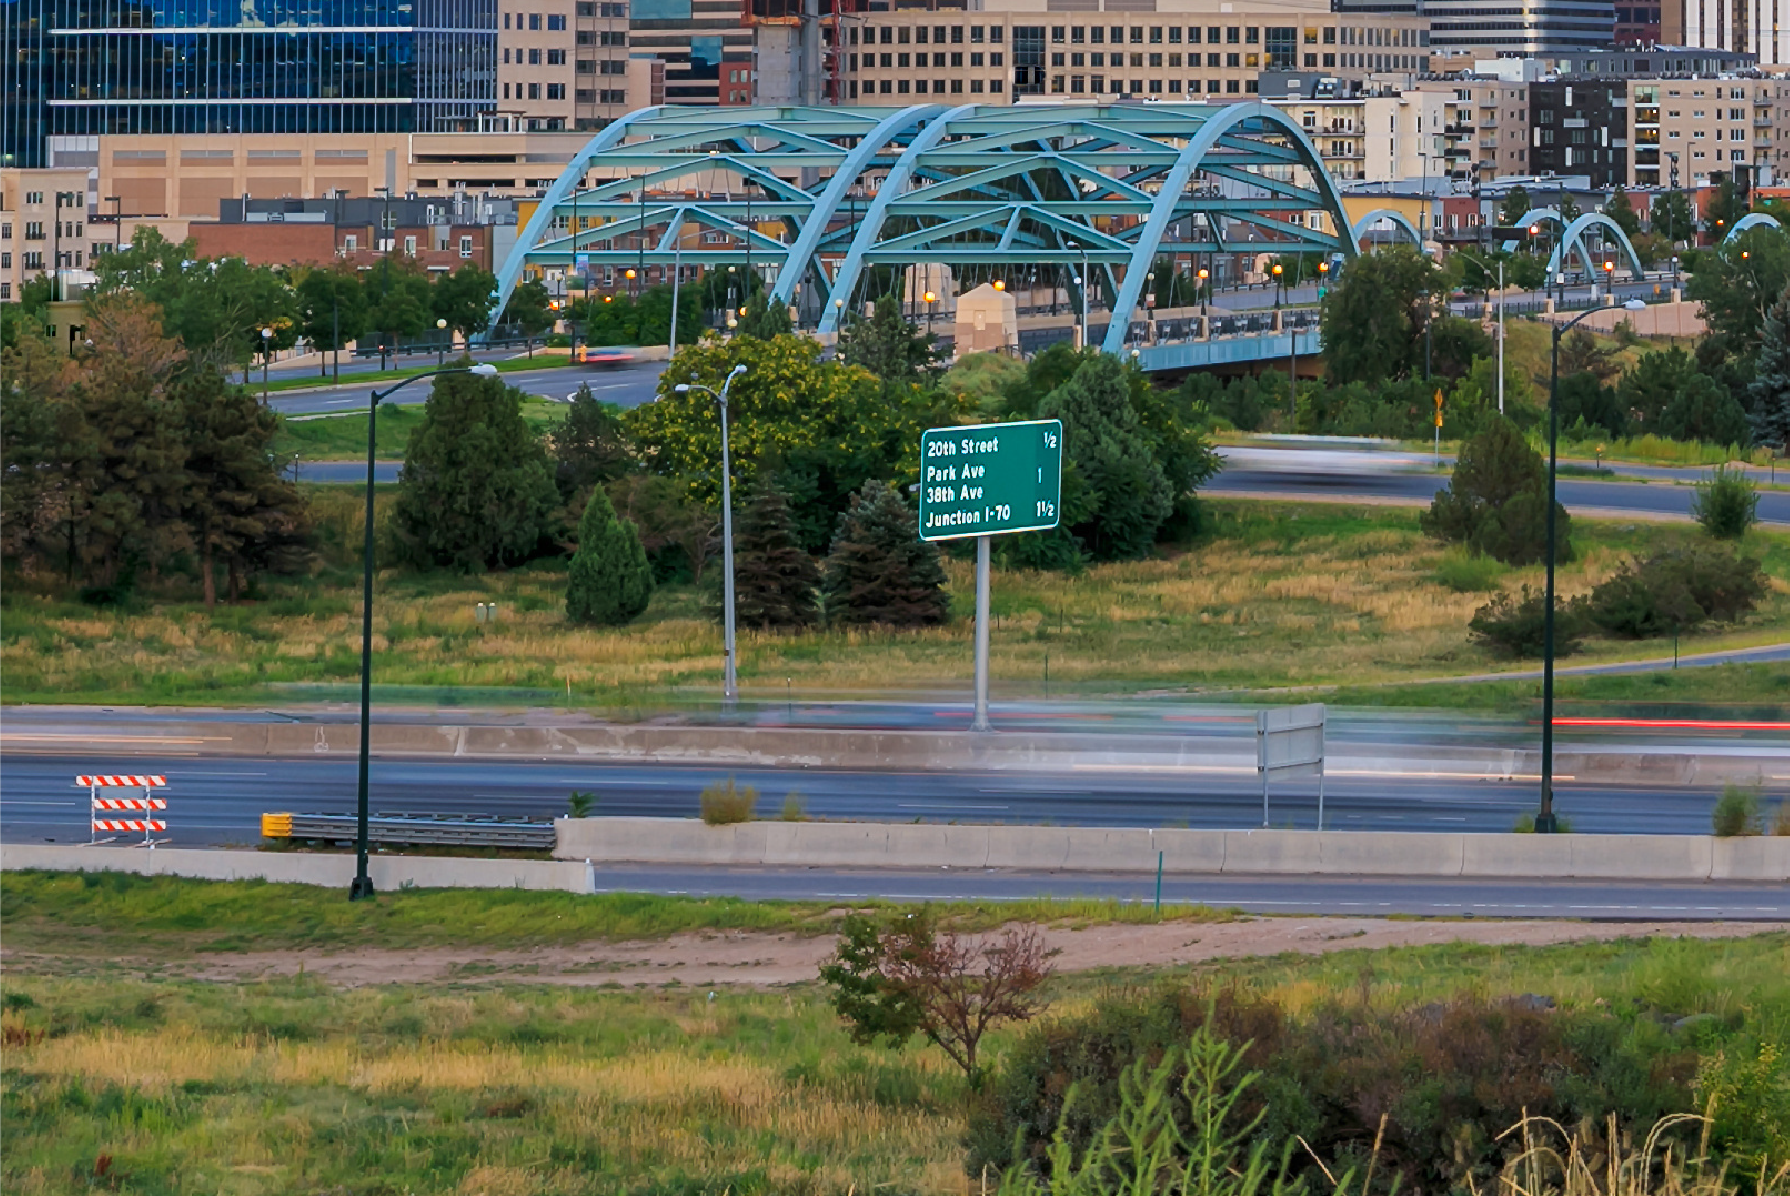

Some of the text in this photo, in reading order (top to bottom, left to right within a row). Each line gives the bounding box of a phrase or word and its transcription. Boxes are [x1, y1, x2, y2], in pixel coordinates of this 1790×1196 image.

[927, 436, 998, 457] 20th Street
[927, 463, 985, 482] Park Ave
[1037, 467, 1042, 484] 1
[926, 484, 983, 503] 38th Ave
[926, 505, 1010, 527] Junction I-70
